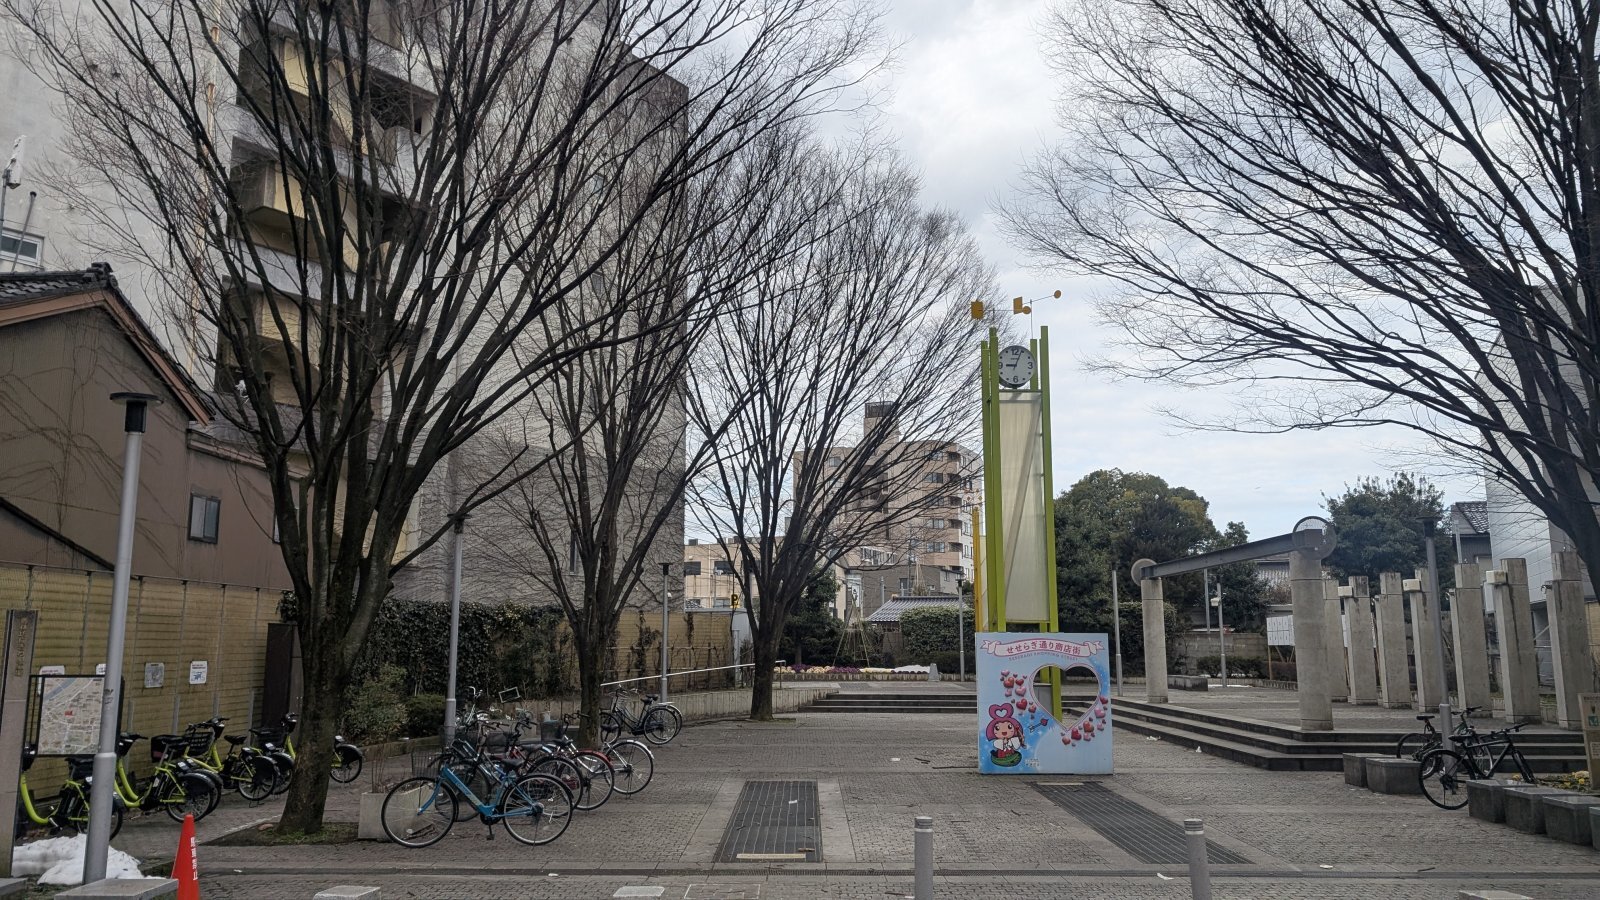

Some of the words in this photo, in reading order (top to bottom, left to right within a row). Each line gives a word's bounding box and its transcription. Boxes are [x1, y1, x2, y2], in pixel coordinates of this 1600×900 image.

[731, 594, 738, 606] P
[1006, 640, 1081, 655] せせらぎ通り商店街
